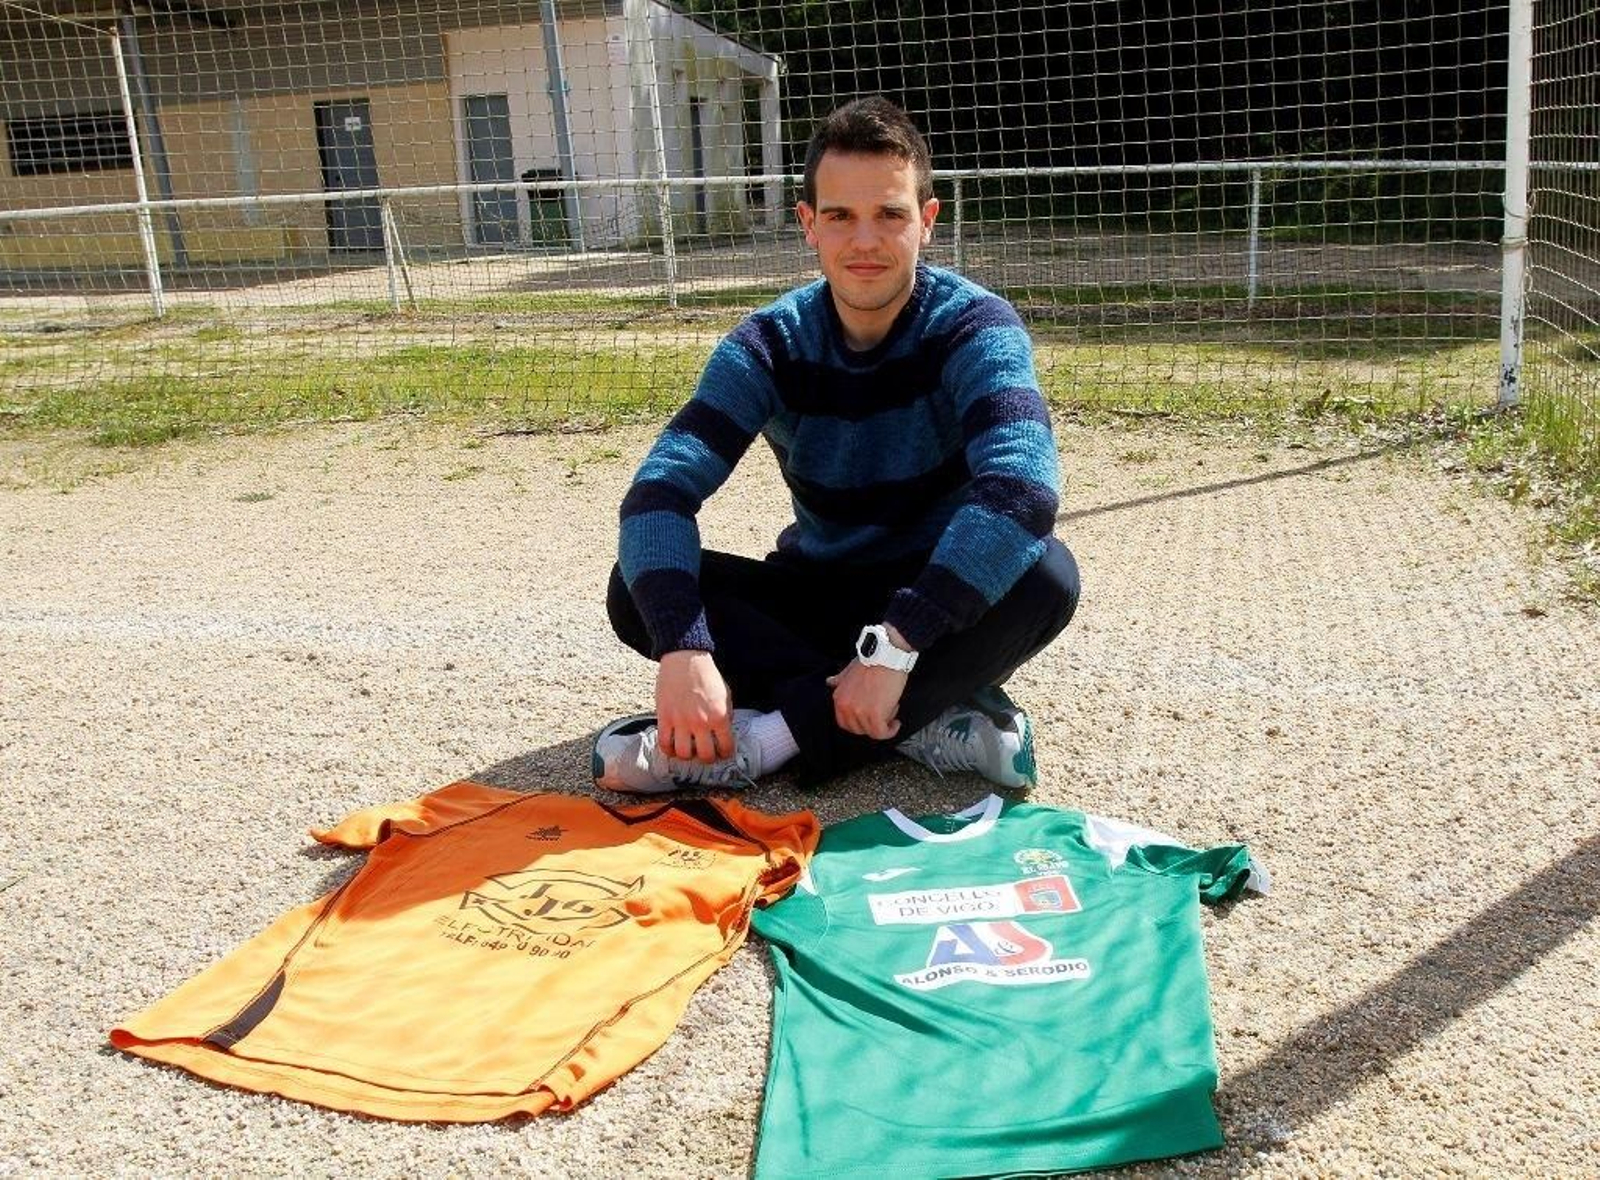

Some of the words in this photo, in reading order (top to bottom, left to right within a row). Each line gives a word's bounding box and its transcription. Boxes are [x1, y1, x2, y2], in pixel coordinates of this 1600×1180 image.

[877, 889, 1002, 908] ONCELLO
[898, 906, 929, 918] DE
[901, 964, 978, 986] ALONSO
[1003, 961, 1089, 978] SERODIO
